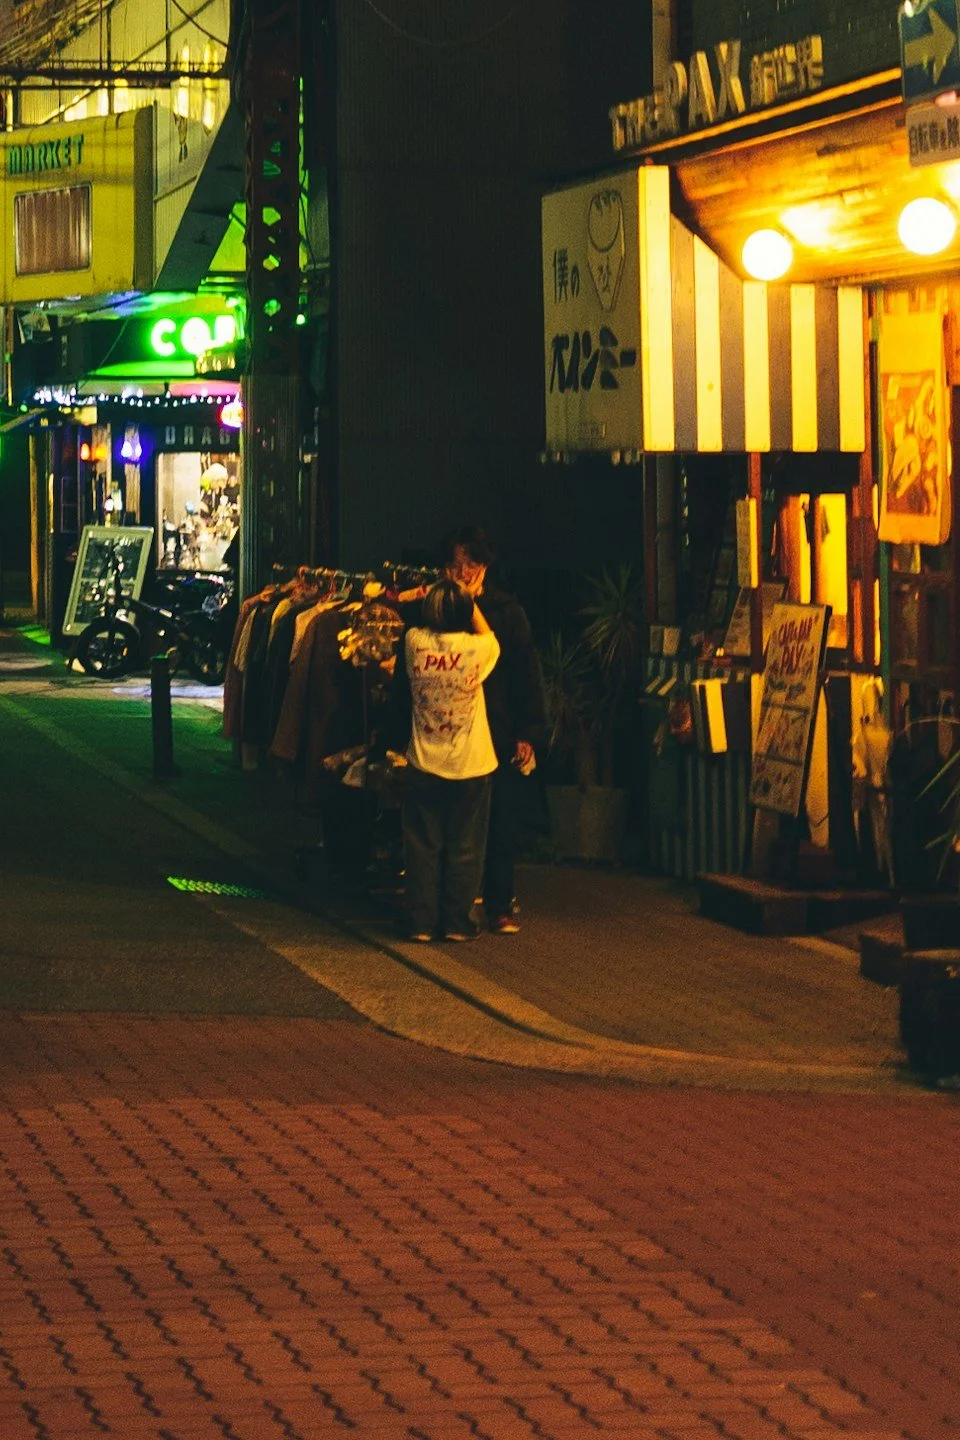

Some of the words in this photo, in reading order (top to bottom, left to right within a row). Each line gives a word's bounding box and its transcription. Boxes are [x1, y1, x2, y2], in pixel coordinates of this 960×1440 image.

[664, 38, 746, 133] PAX
[7, 133, 84, 176] MARKET
[553, 248, 581, 305] 僕の
[423, 652, 462, 671] PAX
